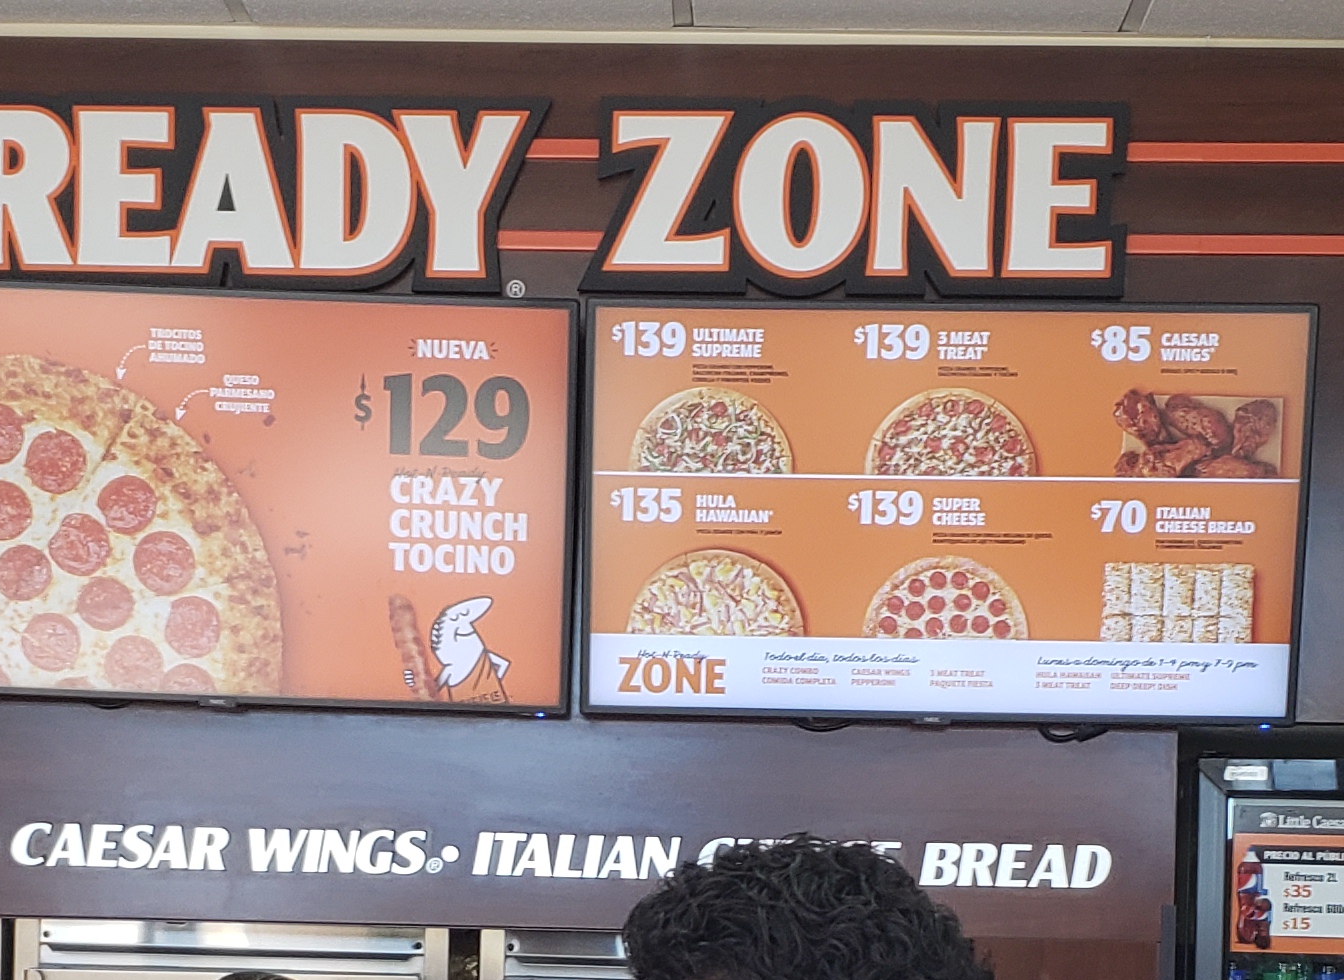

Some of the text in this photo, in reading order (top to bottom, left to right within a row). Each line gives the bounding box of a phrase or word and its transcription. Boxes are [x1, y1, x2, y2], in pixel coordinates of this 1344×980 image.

[601, 110, 1114, 278] ZONE
[611, 320, 687, 358] $139
[691, 327, 765, 342] ULTIMATE
[853, 323, 931, 360] $139
[937, 331, 991, 346] 3 MEAT
[1090, 325, 1152, 362] $85
[1161, 333, 1220, 347] CAESAR
[416, 339, 490, 360] NUEVA
[691, 343, 762, 358] SUPREME
[354, 372, 531, 460] $129
[389, 475, 503, 507] CRAZY
[695, 494, 736, 508] HULA
[610, 487, 683, 523] $135
[847, 490, 924, 526] $139
[932, 498, 981, 511] SUPER
[1156, 507, 1211, 520] ITALIAN
[389, 508, 528, 542] CRUNCH
[932, 512, 986, 526] CHEESE
[1090, 500, 1147, 534] $70
[1155, 520, 1255, 534] CHEESE BREAD
[387, 542, 515, 576] TOCINO
[617, 656, 727, 695] ZONE
[1277, 815, 1311, 829] Little
[10, 822, 232, 872] CAESAR
[249, 828, 432, 876] WINGS
[471, 831, 681, 880] ITALIAN
[918, 842, 1114, 891] BREAD
[1263, 850, 1300, 860] PRECIO
[1301, 851, 1315, 861] AL
[1283, 885, 1312, 898] $35
[1282, 917, 1311, 930] $15
